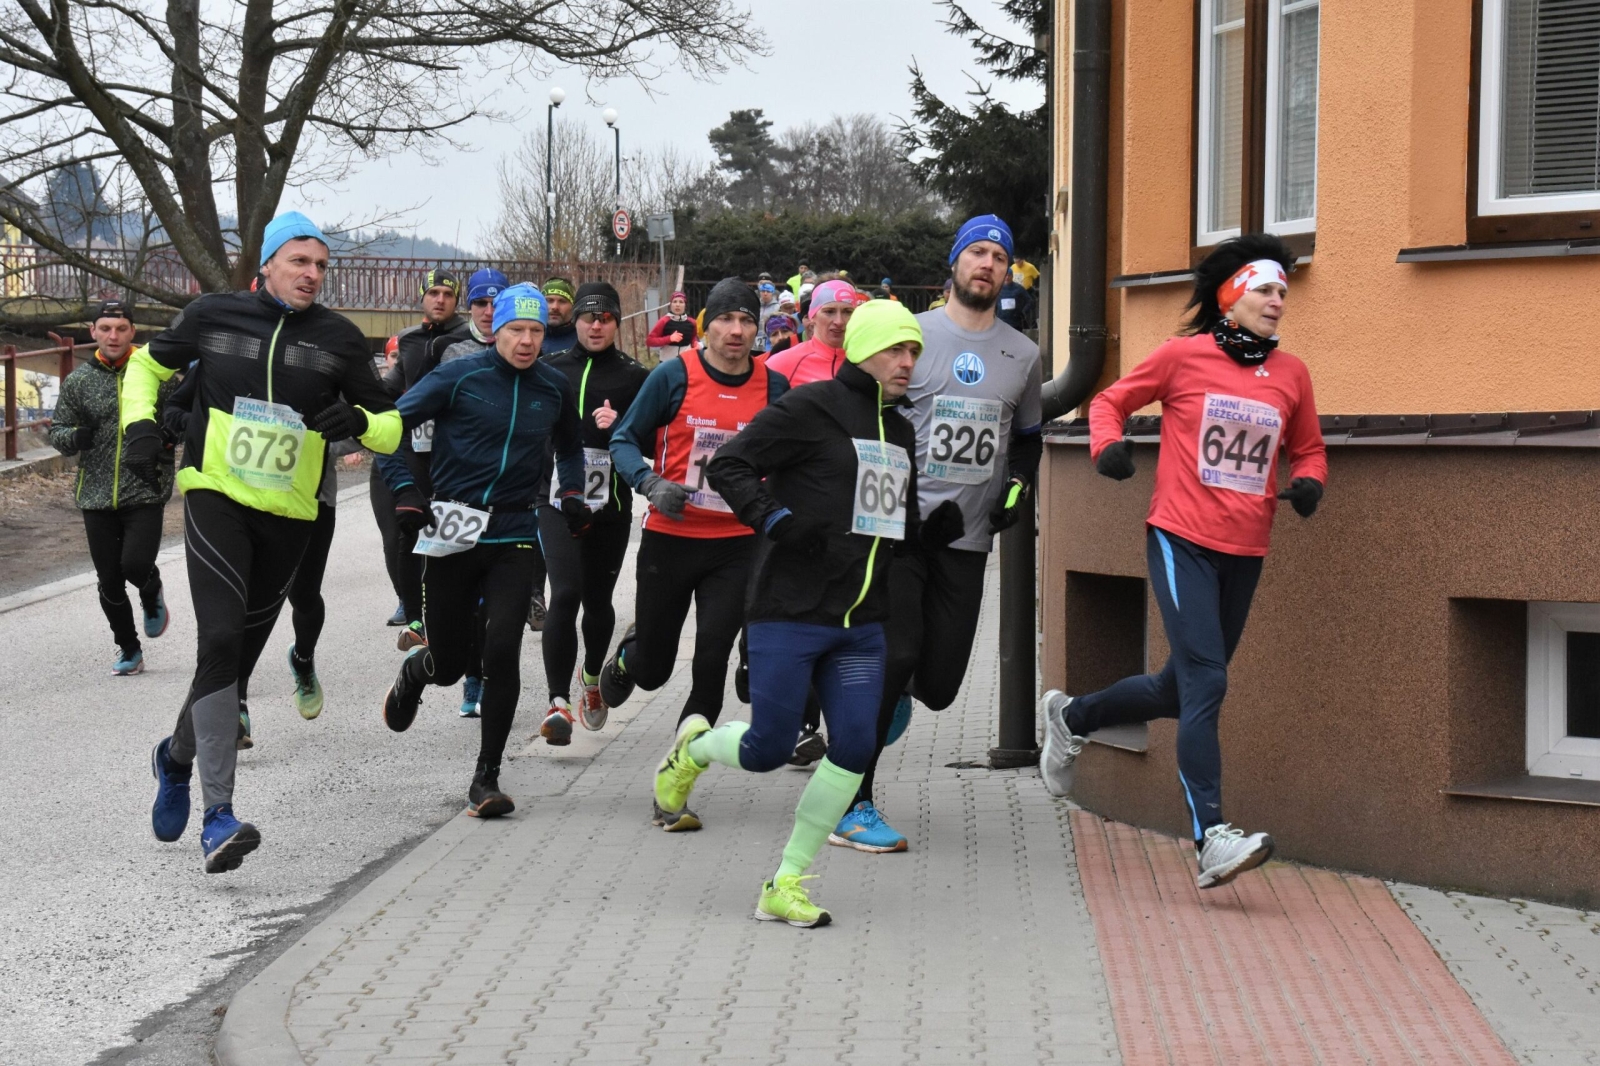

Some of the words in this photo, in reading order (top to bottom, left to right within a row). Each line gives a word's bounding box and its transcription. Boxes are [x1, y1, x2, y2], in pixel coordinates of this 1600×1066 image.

[515, 299, 541, 310] SWEEP
[237, 401, 267, 413] ZIMNÍ
[936, 399, 965, 409] ZIMNÍ
[1209, 398, 1240, 410] ZIMNÍ
[980, 413, 998, 422] LIGA
[1256, 416, 1279, 428] LIGA
[281, 420, 303, 430] LIGA
[698, 431, 724, 441] ZIMNÍ
[230, 426, 298, 472] 673
[696, 440, 724, 449] BĚŽEC
[931, 423, 995, 466] 326
[1202, 424, 1272, 474] 644
[894, 460, 909, 470] LIGA
